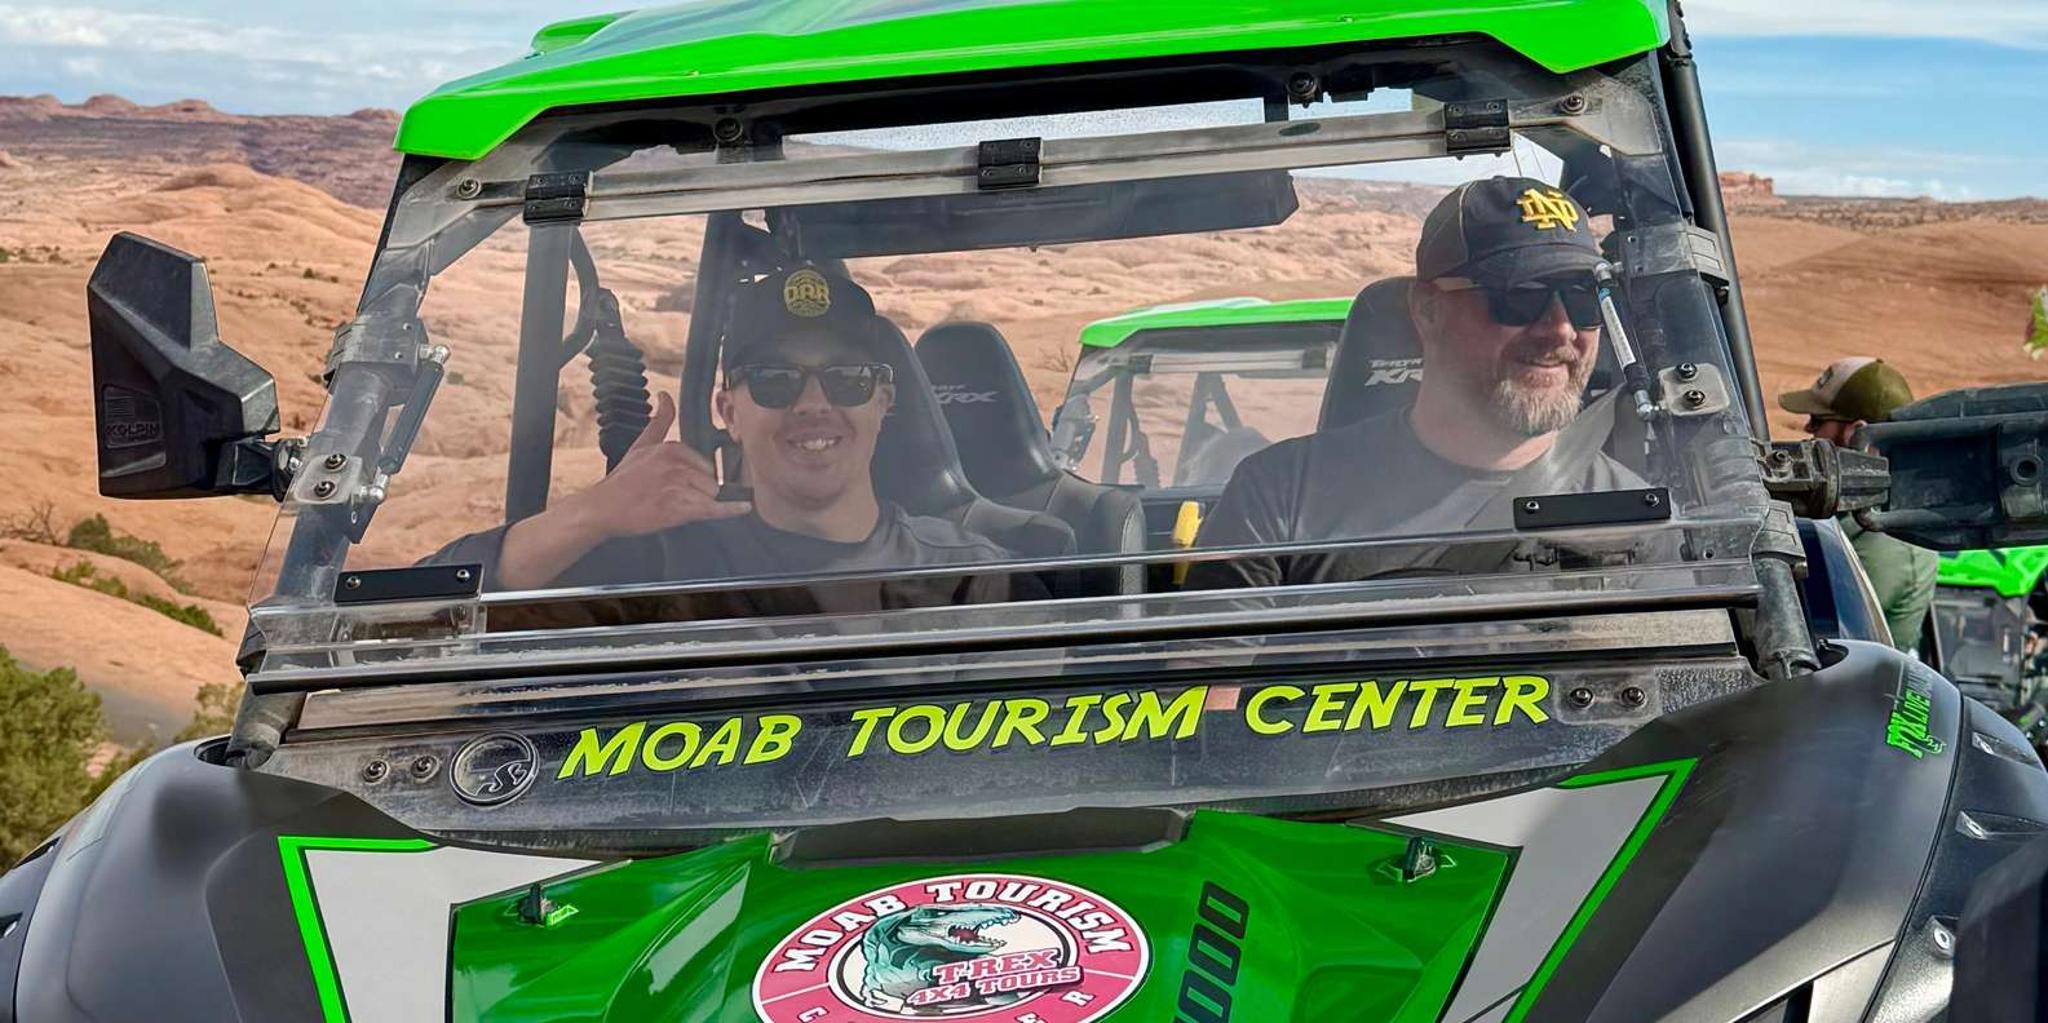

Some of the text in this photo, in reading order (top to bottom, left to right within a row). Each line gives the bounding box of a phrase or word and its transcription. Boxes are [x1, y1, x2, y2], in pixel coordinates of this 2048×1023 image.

[1364, 369, 1424, 386] KR
[105, 422, 160, 436] KOLPIN
[556, 675, 1550, 781] MOAB TOURISM CENTER
[773, 878, 1133, 973] MOAB TOURISM
[1173, 880, 1250, 1023] 000
[974, 966, 1082, 997] TOURS
